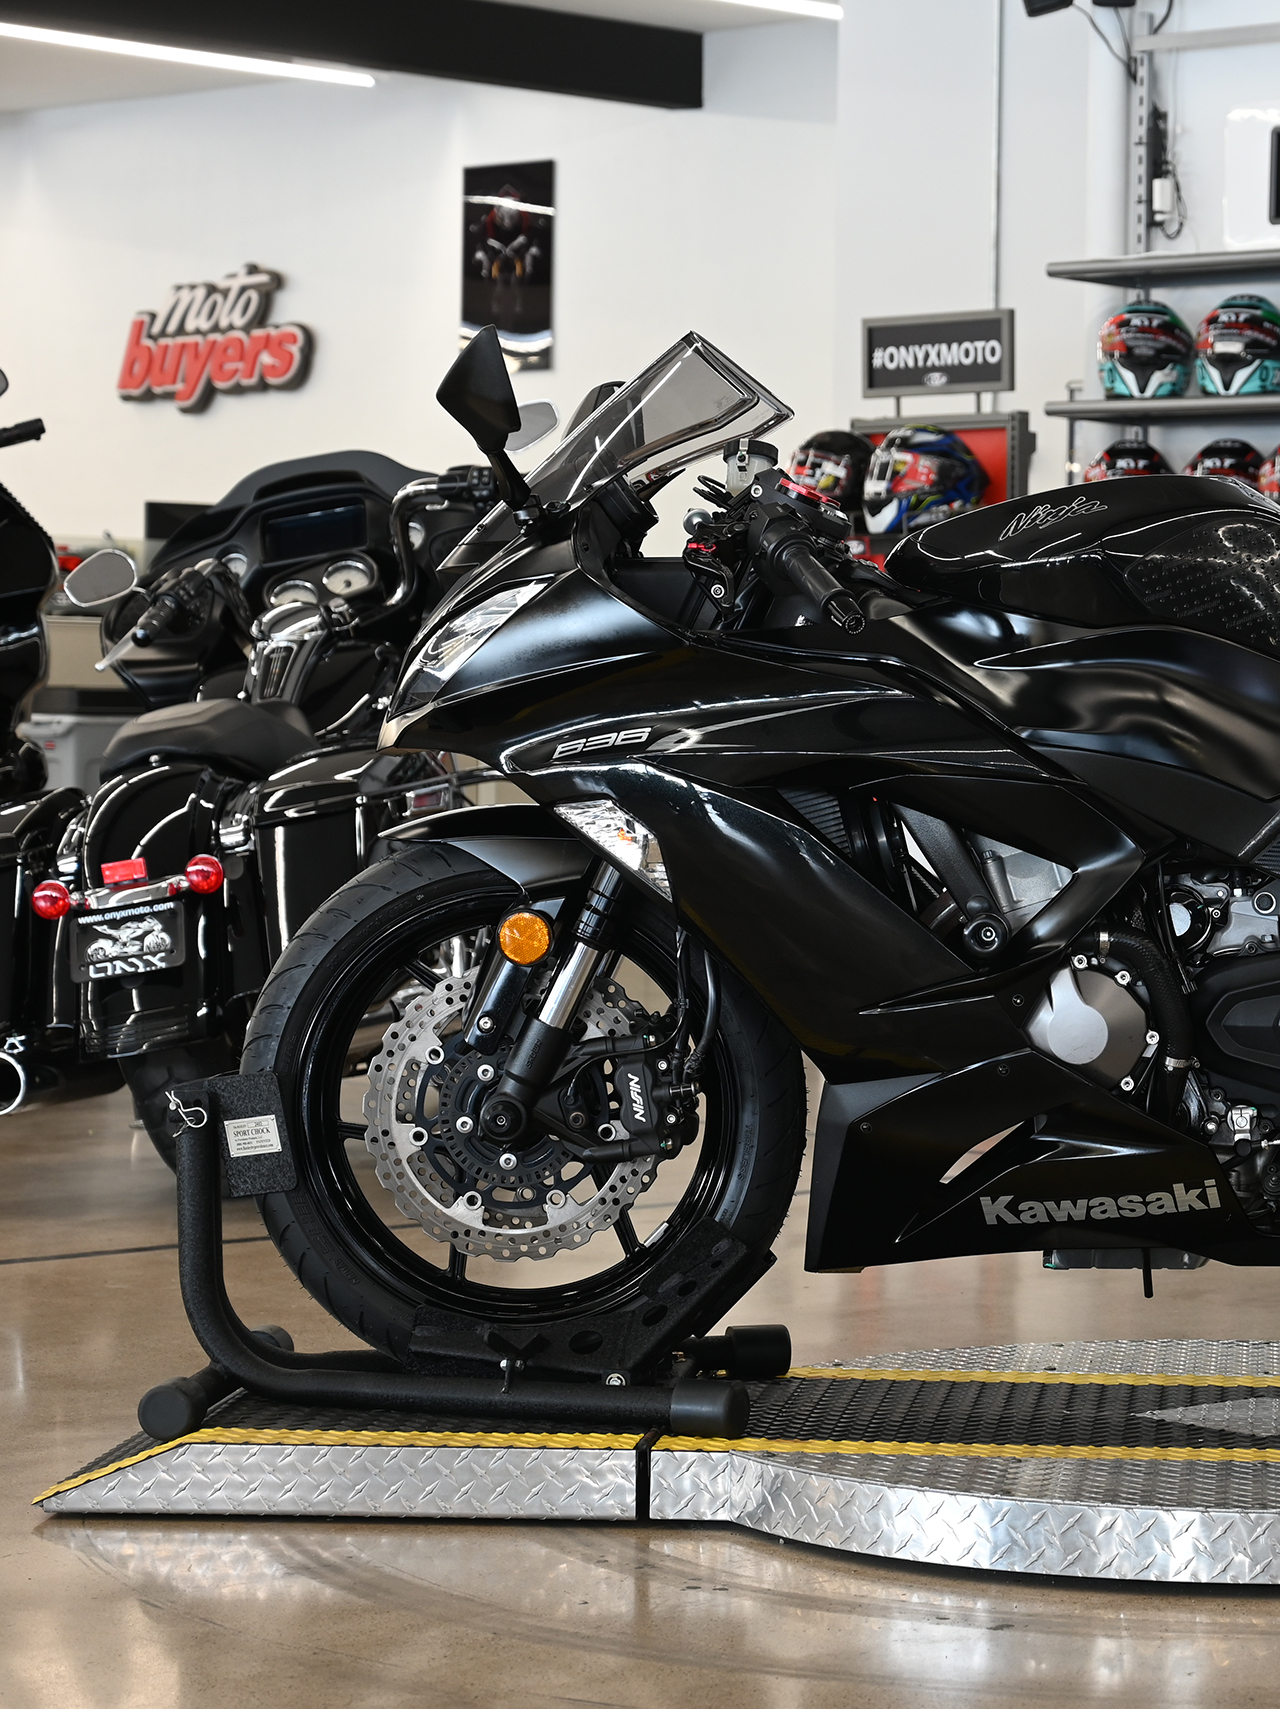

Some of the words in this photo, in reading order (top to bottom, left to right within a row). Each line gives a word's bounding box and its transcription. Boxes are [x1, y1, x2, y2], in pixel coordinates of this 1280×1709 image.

[150, 263, 271, 336] Moto
[117, 315, 301, 404] buyers
[872, 339, 1003, 370] #ONYXMOTO
[998, 496, 1108, 542] Ninja
[552, 727, 652, 760] 636
[78, 901, 174, 925] www.onyxmoto.com
[627, 1072, 647, 1123] NISSIN
[233, 1129, 250, 1138] SPORT
[250, 1126, 271, 1136] CHOCK
[979, 1178, 1222, 1225] Kawasaki
